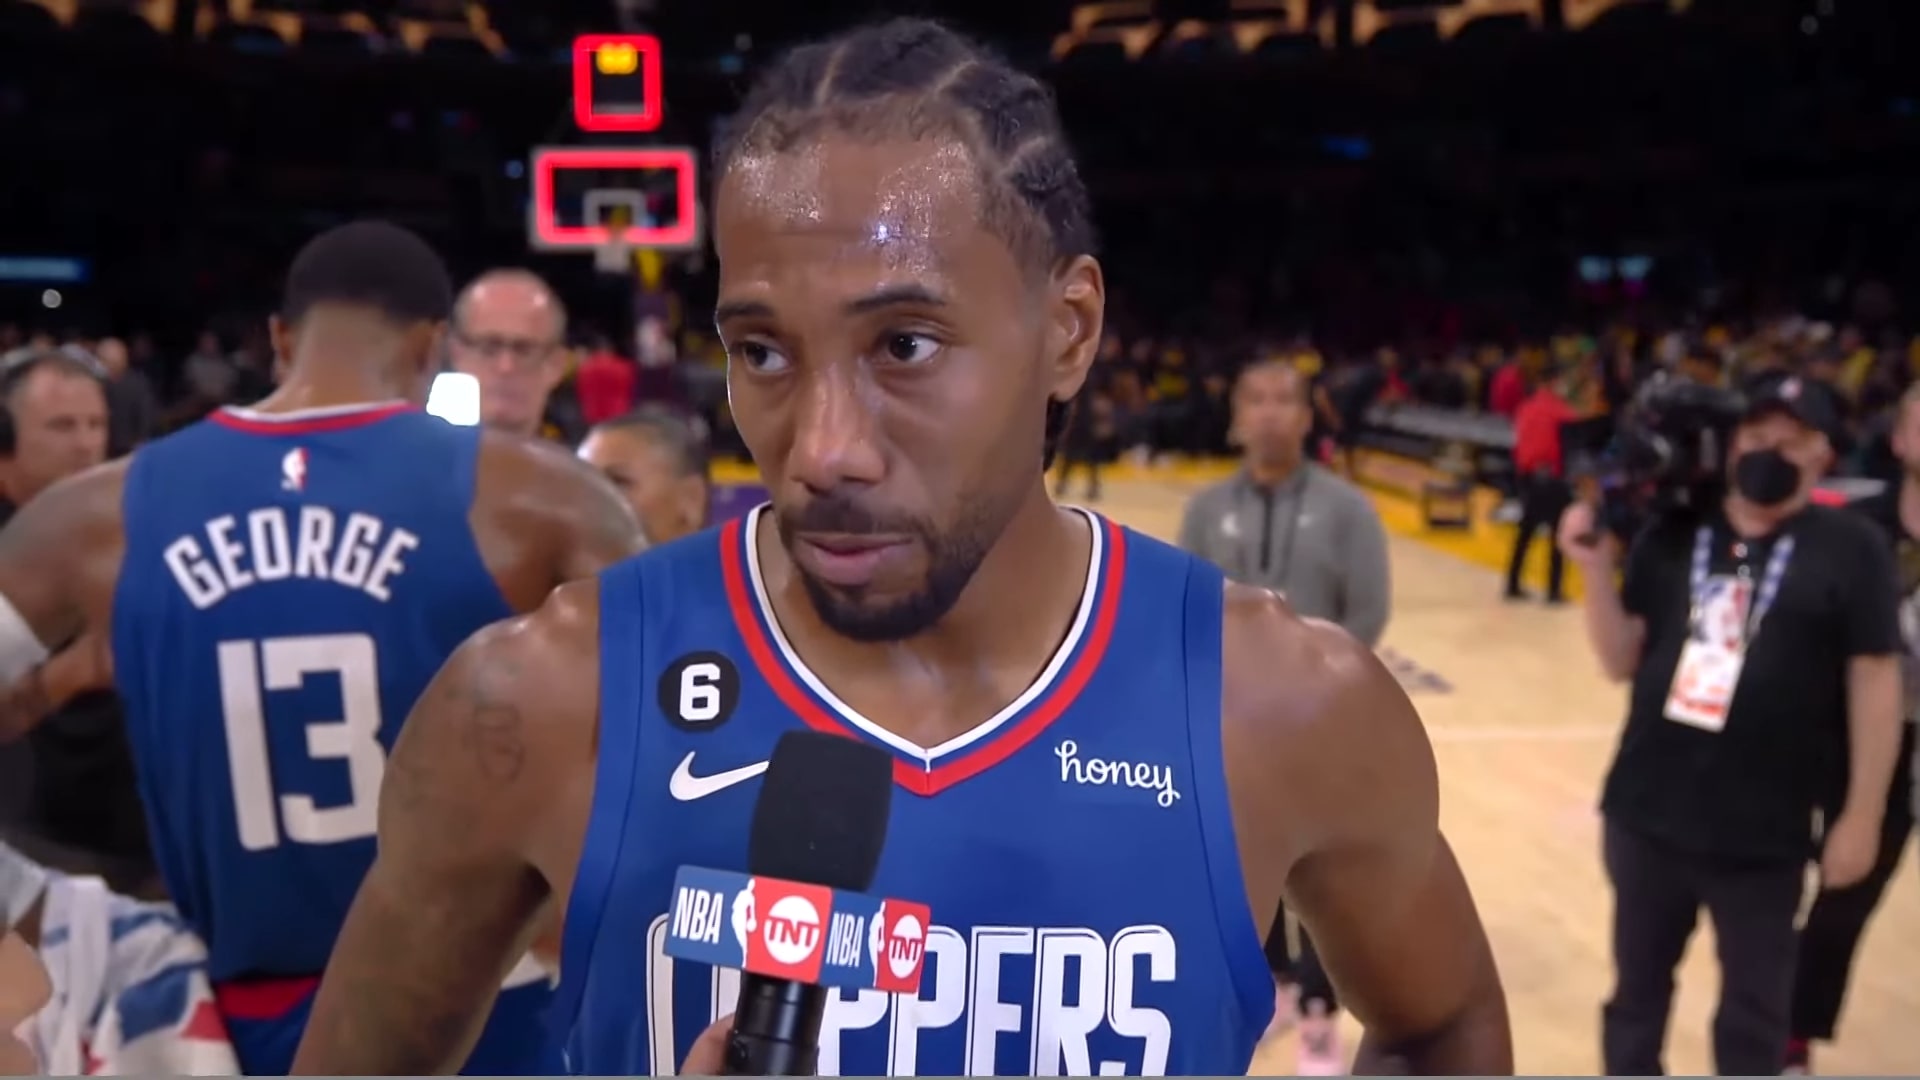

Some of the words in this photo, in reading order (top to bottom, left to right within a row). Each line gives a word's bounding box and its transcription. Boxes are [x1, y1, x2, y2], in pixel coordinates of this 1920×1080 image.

[163, 505, 419, 609] GEORGE
[679, 662, 721, 721] 6
[217, 633, 387, 851] 13
[1054, 739, 1181, 807] honey
[672, 887, 724, 944] NBA
[763, 916, 820, 948] TNT
[825, 912, 865, 968] NBA
